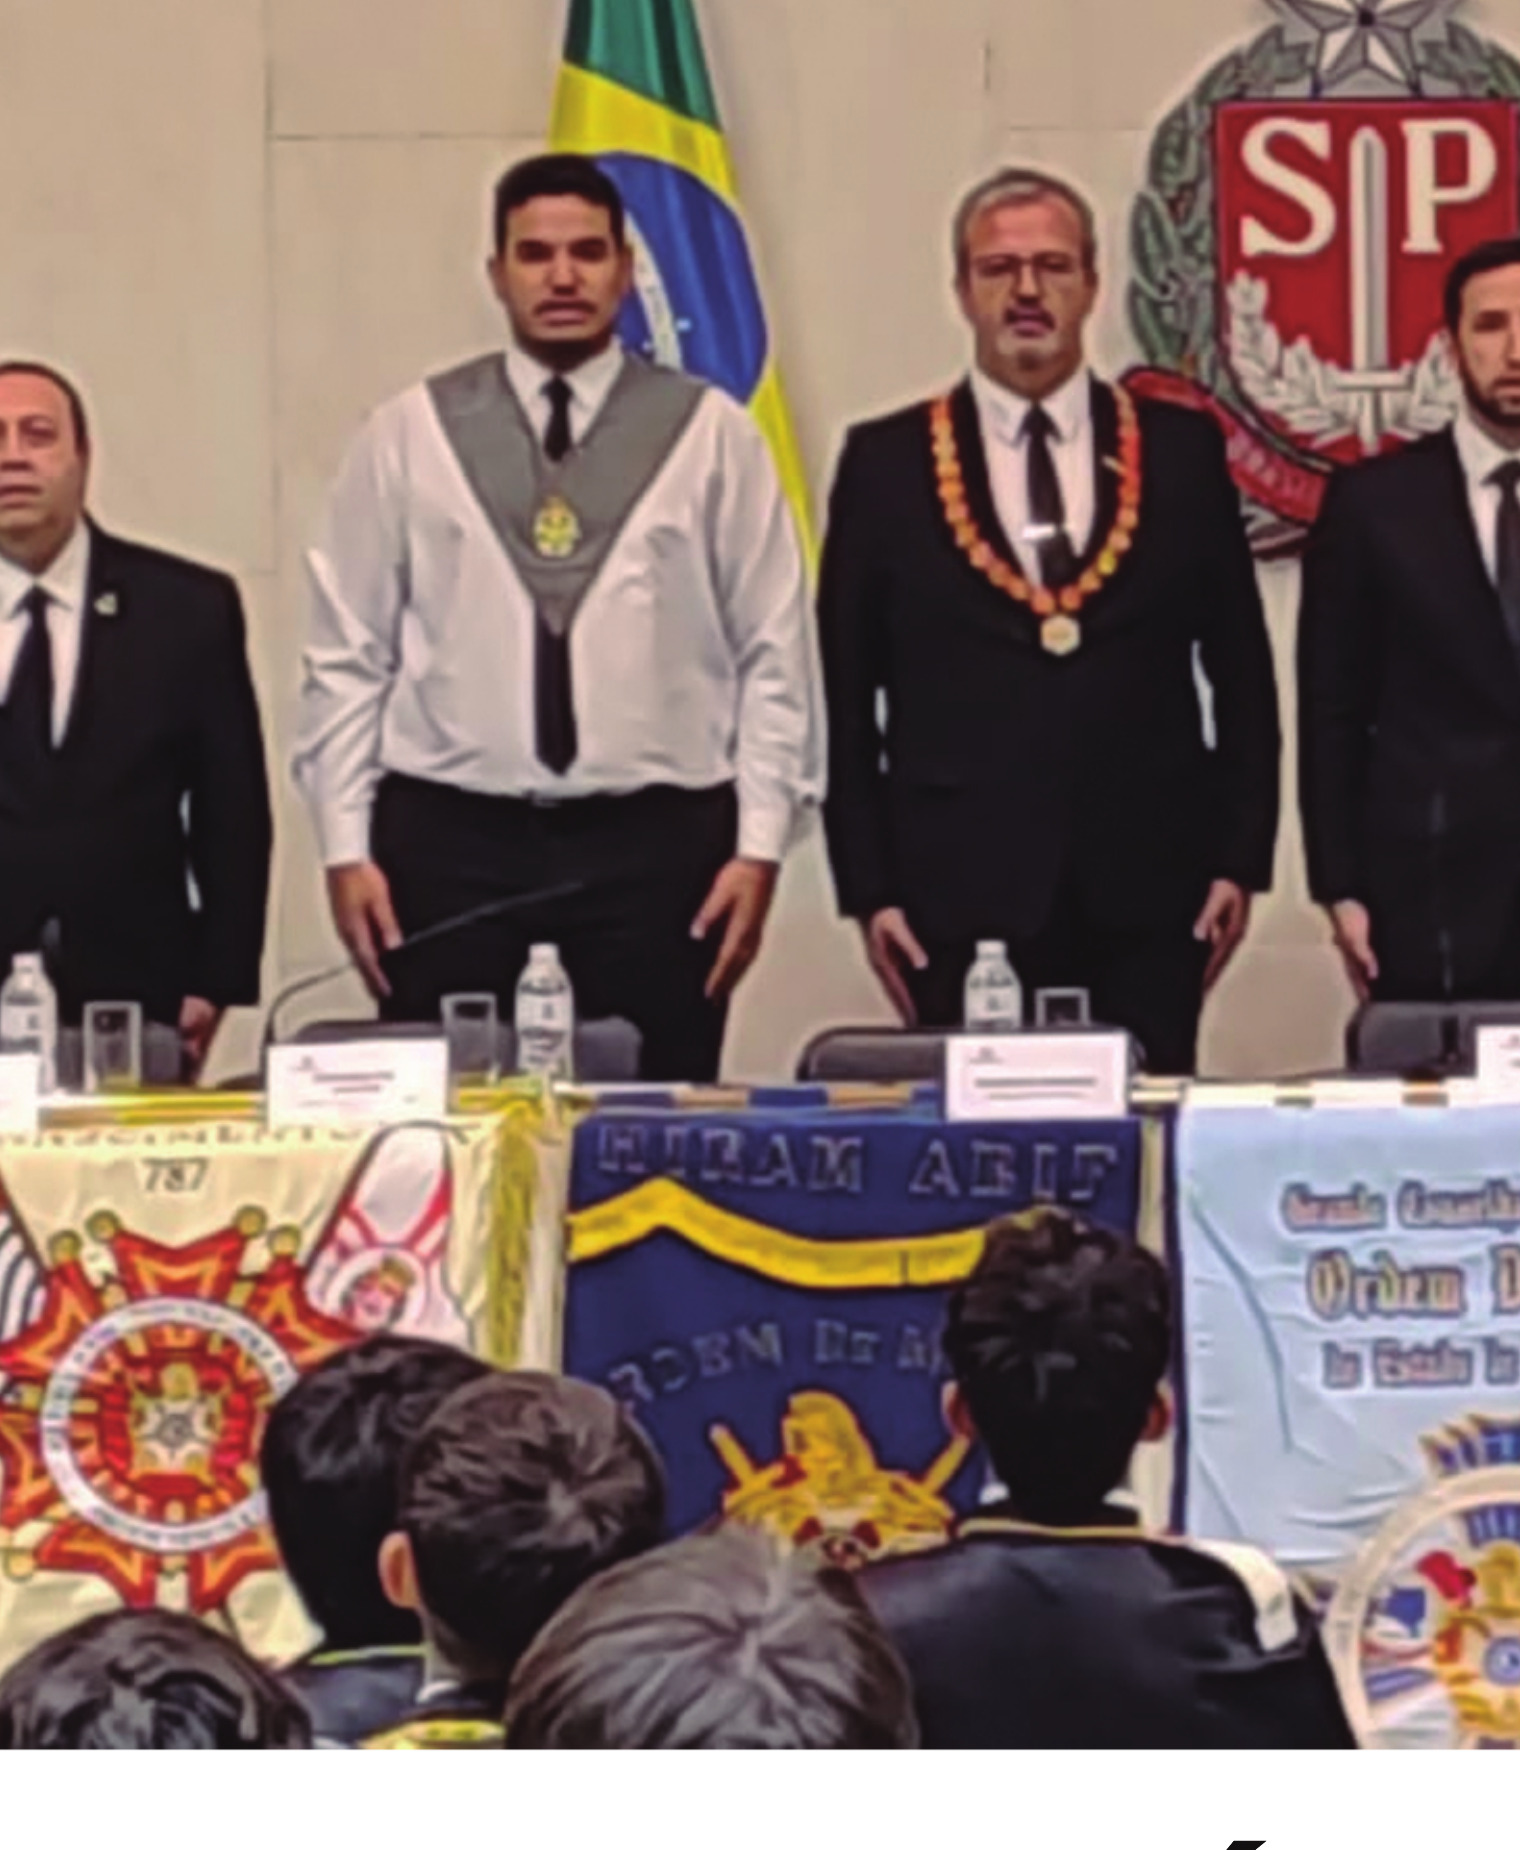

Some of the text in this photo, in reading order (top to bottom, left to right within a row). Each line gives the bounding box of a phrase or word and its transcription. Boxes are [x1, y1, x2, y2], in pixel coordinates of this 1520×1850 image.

[142, 1156, 210, 1192] 787
[599, 1125, 1119, 1200] HIRAM ABIF
[1307, 1247, 1467, 1322] Ordem
